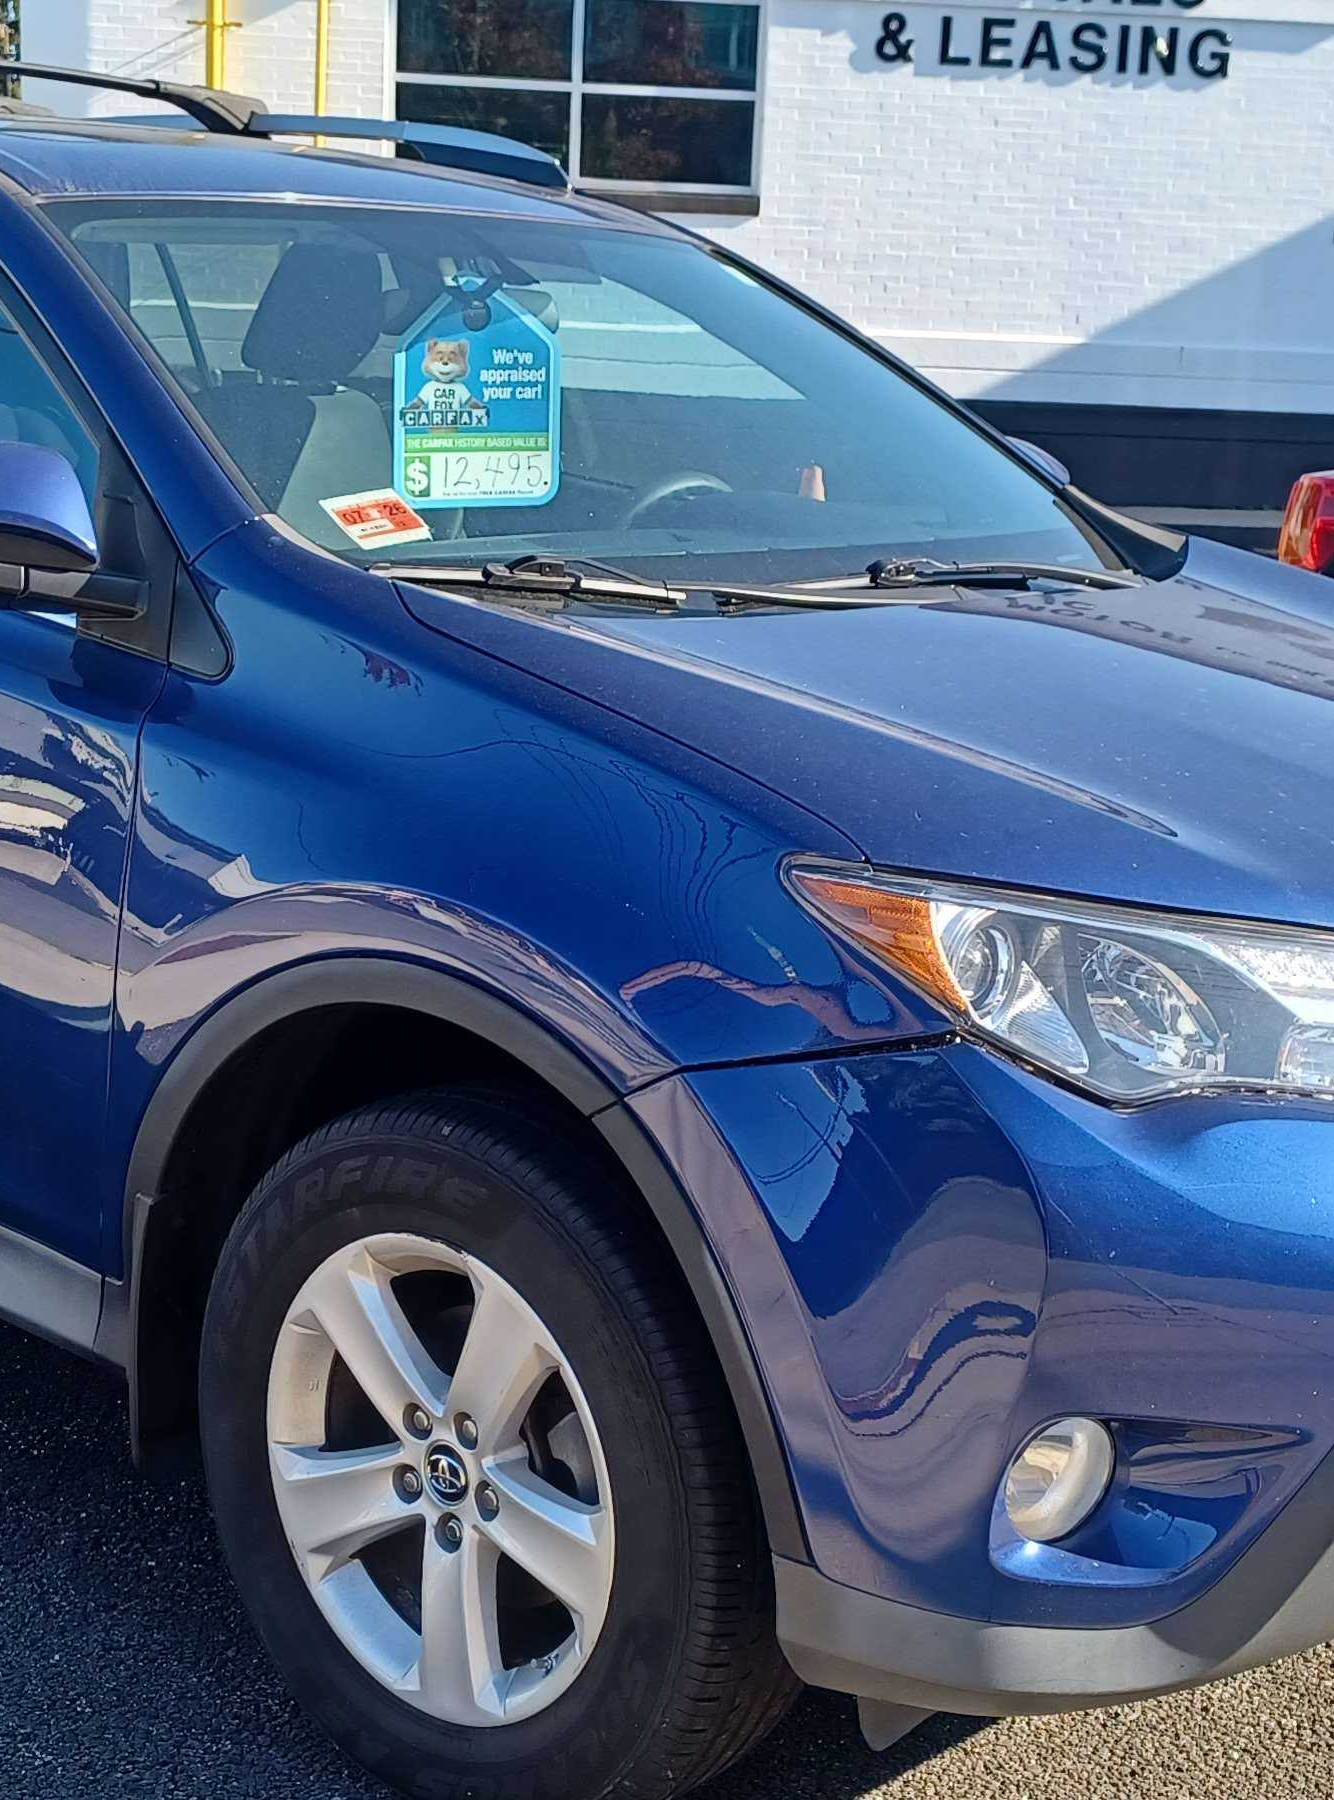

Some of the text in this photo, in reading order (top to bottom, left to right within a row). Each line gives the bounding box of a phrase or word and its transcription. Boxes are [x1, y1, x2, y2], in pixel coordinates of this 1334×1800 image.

[875, 12, 1233, 79] & LEASING
[492, 348, 534, 365] We've
[479, 366, 546, 385] appraised
[434, 388, 456, 400] CAR
[482, 385, 542, 402] your car!
[434, 400, 454, 410] FOX
[405, 410, 485, 427] CARFAX
[406, 457, 428, 496] $
[342, 510, 365, 524] 07
[382, 502, 407, 516] 26
